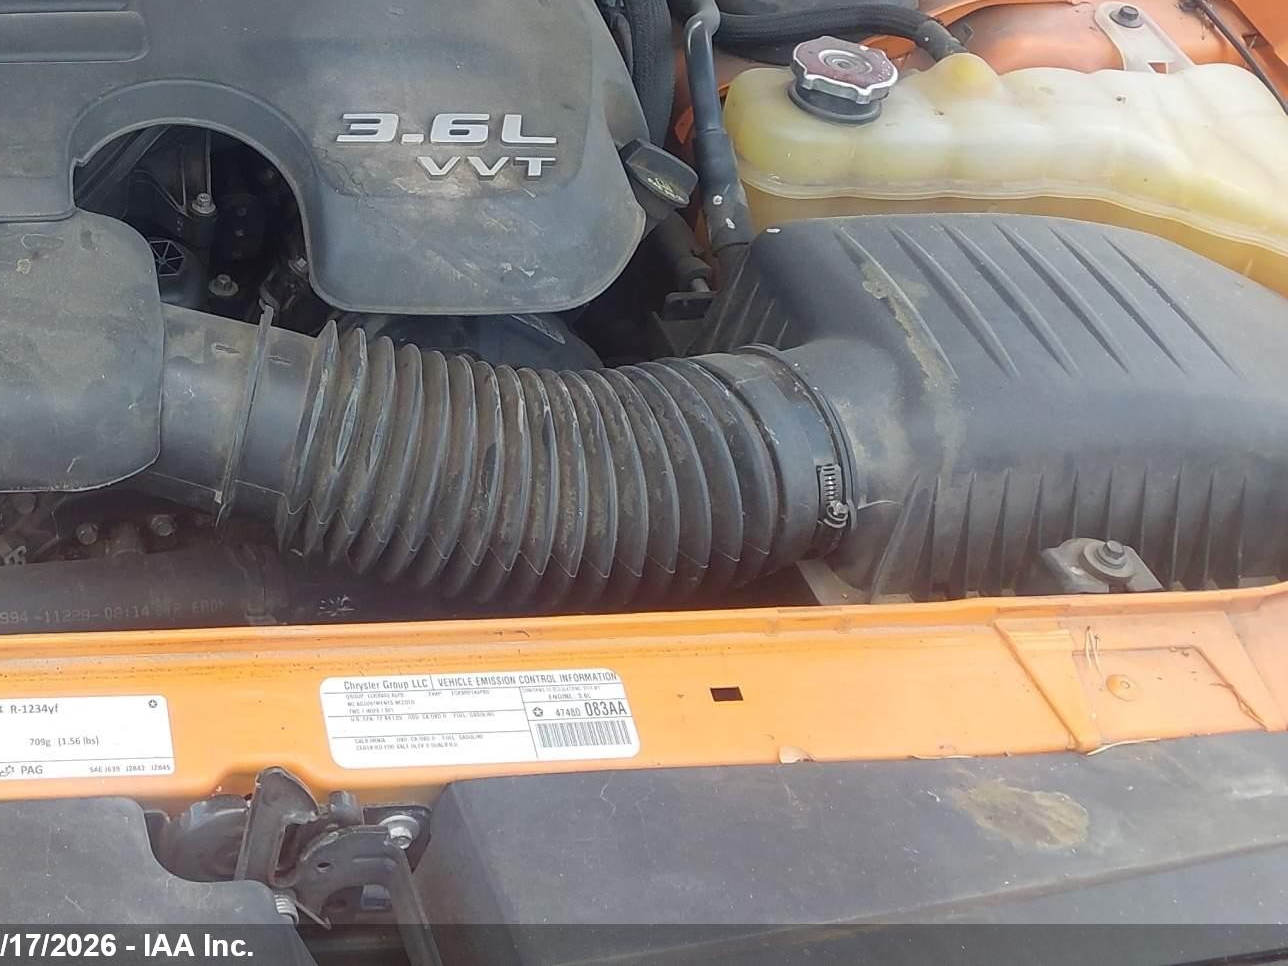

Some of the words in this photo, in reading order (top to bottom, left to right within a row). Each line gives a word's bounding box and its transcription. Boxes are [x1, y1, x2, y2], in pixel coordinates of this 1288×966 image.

[336, 113, 558, 146] 3.6L
[417, 156, 557, 180] VVT
[344, 679, 380, 692] Chrysler
[383, 679, 409, 691] Group
[411, 678, 428, 689] LLC
[437, 677, 473, 688] VEHICLE
[476, 676, 516, 686] EMISSION
[518, 674, 557, 684] CONTROL
[559, 672, 618, 683] INFORMATION
[10, 703, 59, 716] R-1234yf
[584, 701, 628, 717] 083AA
[29, 738, 52, 748] 709g
[58, 736, 81, 747] (1.56
[83, 735, 100, 747] lbs)
[20, 765, 44, 776] PAG
